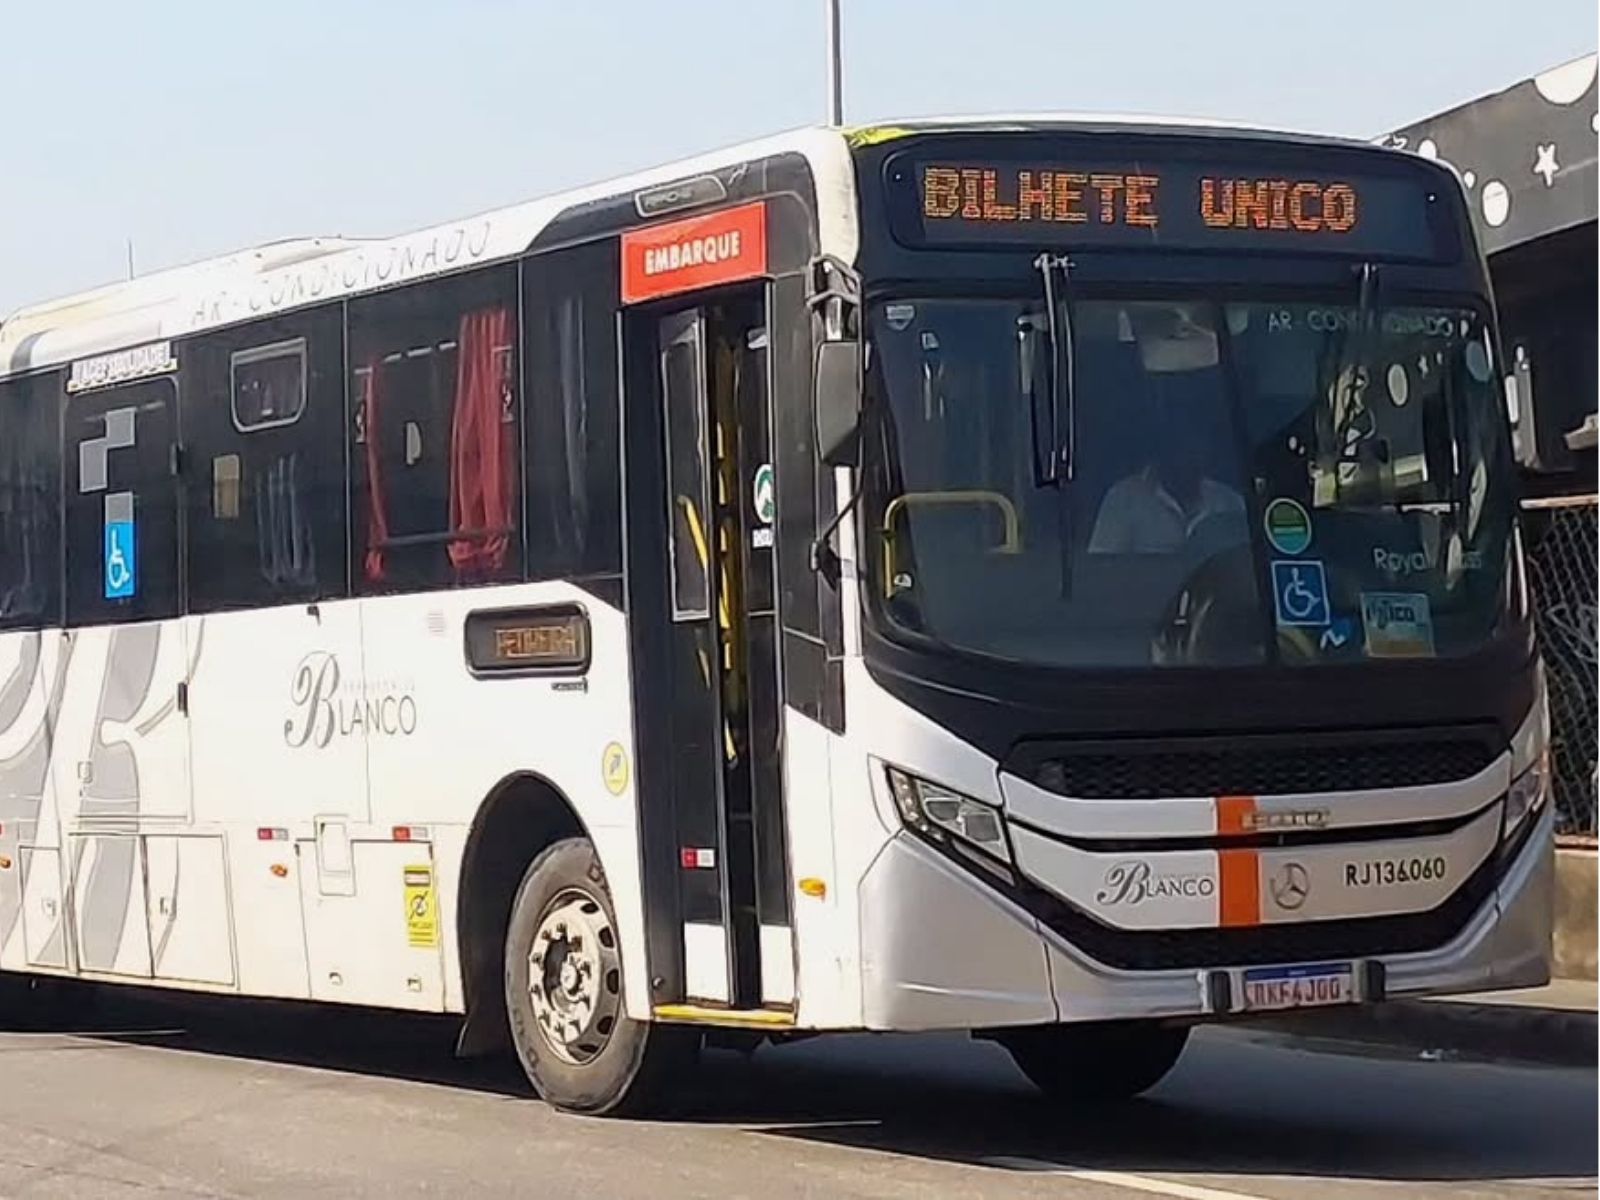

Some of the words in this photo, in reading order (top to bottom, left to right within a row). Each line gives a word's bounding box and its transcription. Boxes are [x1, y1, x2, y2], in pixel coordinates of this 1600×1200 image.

[923, 166, 1160, 226] BILHETE
[1200, 176, 1358, 232] UNICO
[644, 230, 741, 276] EMBARQUE
[284, 649, 417, 749] BLANCO
[1096, 860, 1215, 905] BLANCO
